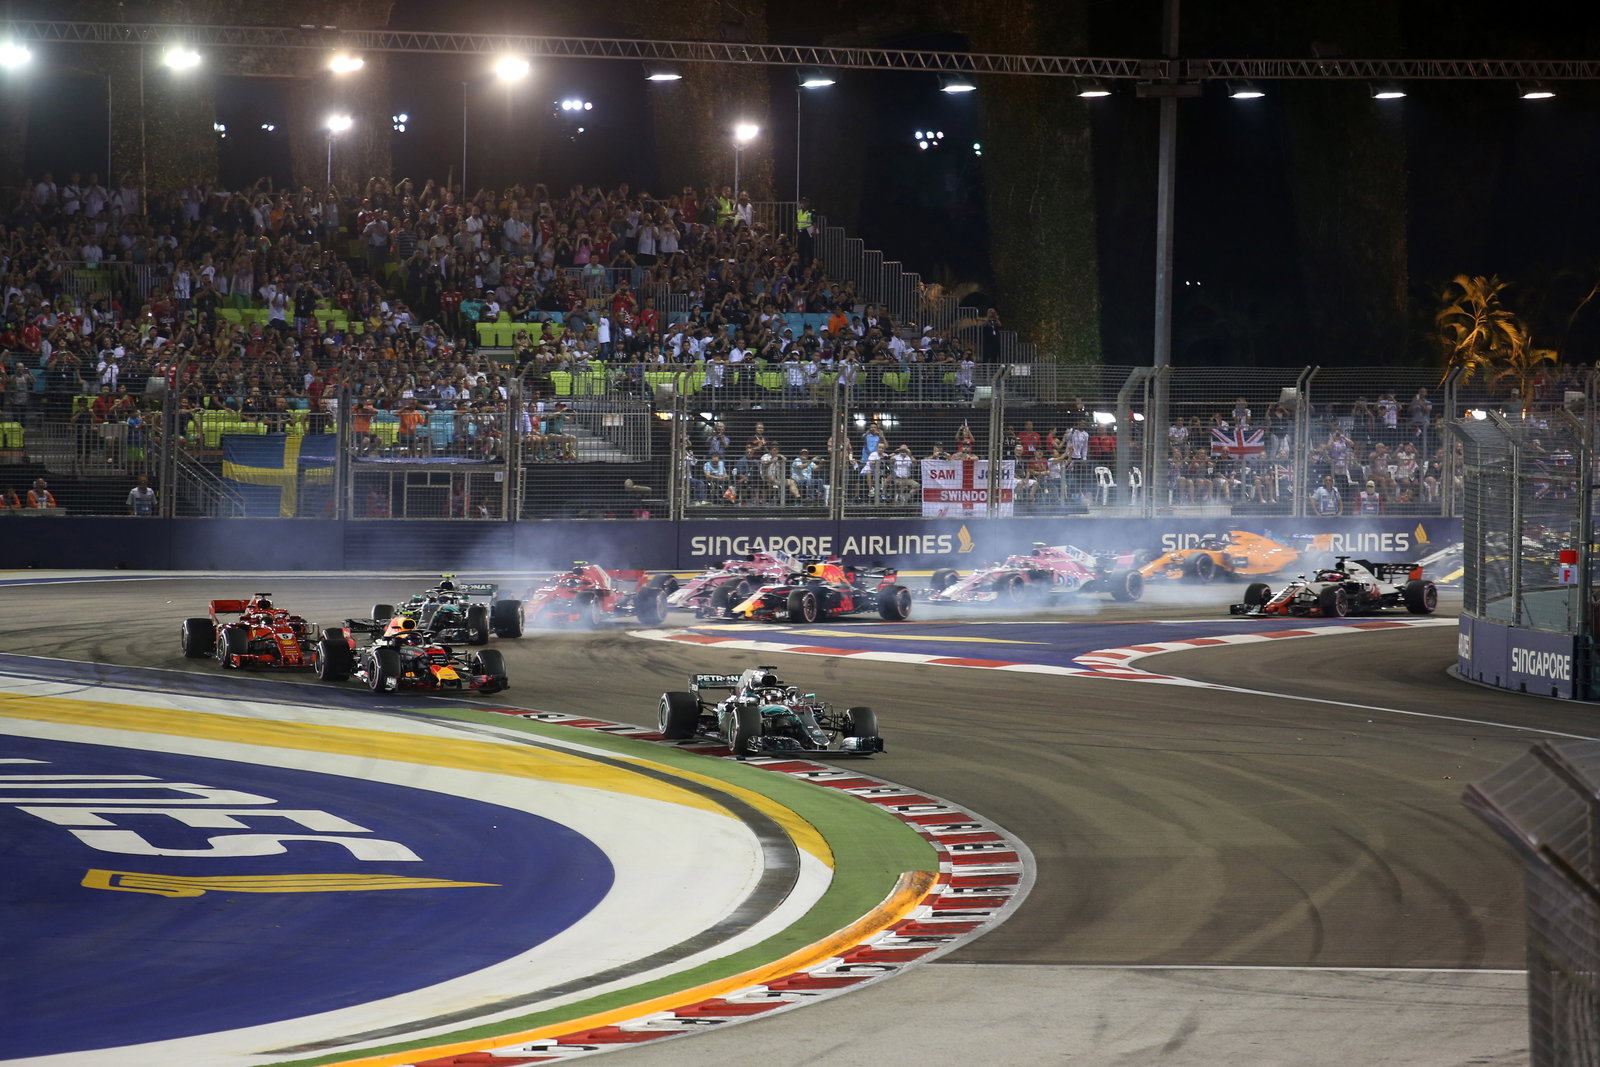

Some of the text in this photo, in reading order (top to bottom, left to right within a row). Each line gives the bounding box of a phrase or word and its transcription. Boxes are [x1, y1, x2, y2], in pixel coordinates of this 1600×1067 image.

[930, 469, 956, 480] SAM
[977, 469, 1010, 480] JH
[940, 490, 987, 501] SWINDO
[691, 534, 952, 556] SINGAPORE AIRLINES
[1563, 569, 1571, 582] F
[1511, 647, 1571, 681] SINGAPORE
